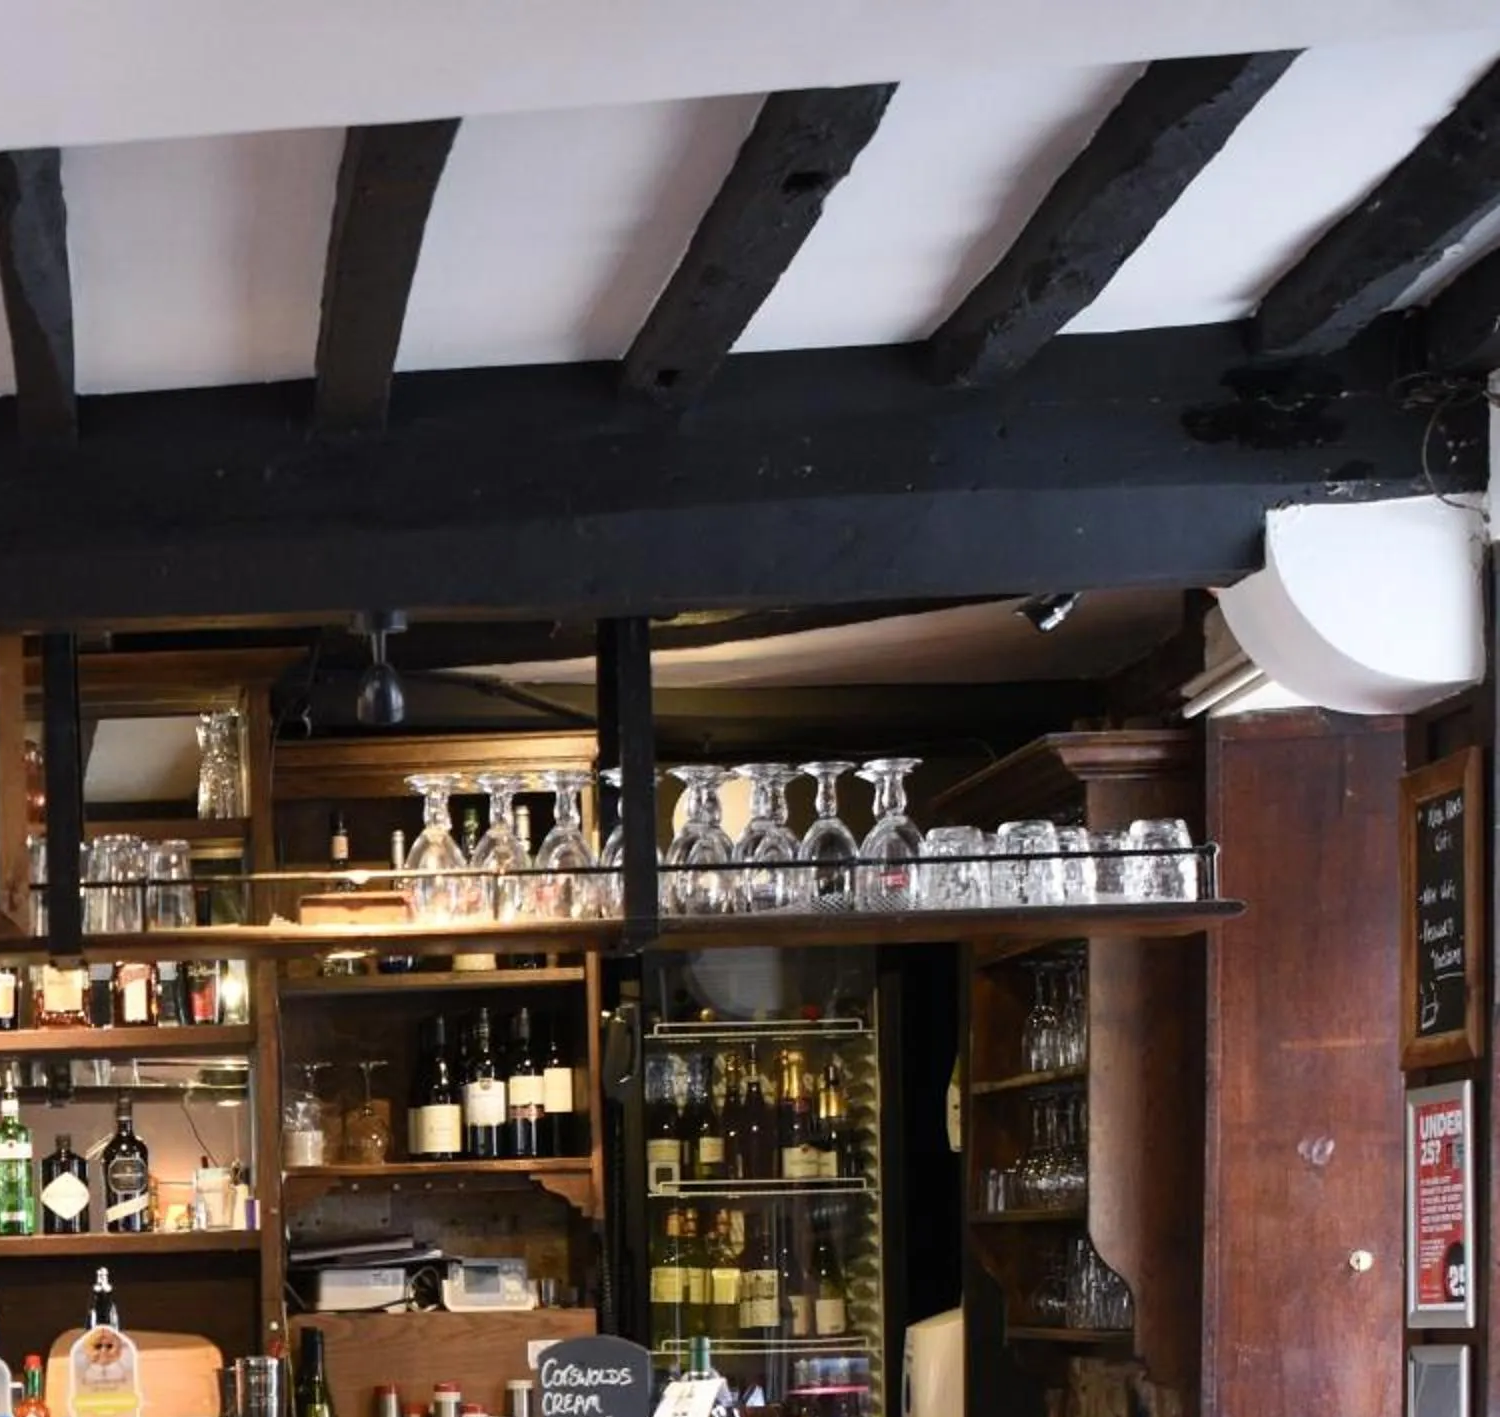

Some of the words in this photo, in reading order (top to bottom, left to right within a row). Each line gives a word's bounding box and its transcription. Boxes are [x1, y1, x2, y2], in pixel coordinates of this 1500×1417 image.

[1419, 1109, 1463, 1140] UNDER
[541, 1357, 634, 1389] COTSWOLDS
[542, 1390, 603, 1417] CREAM
